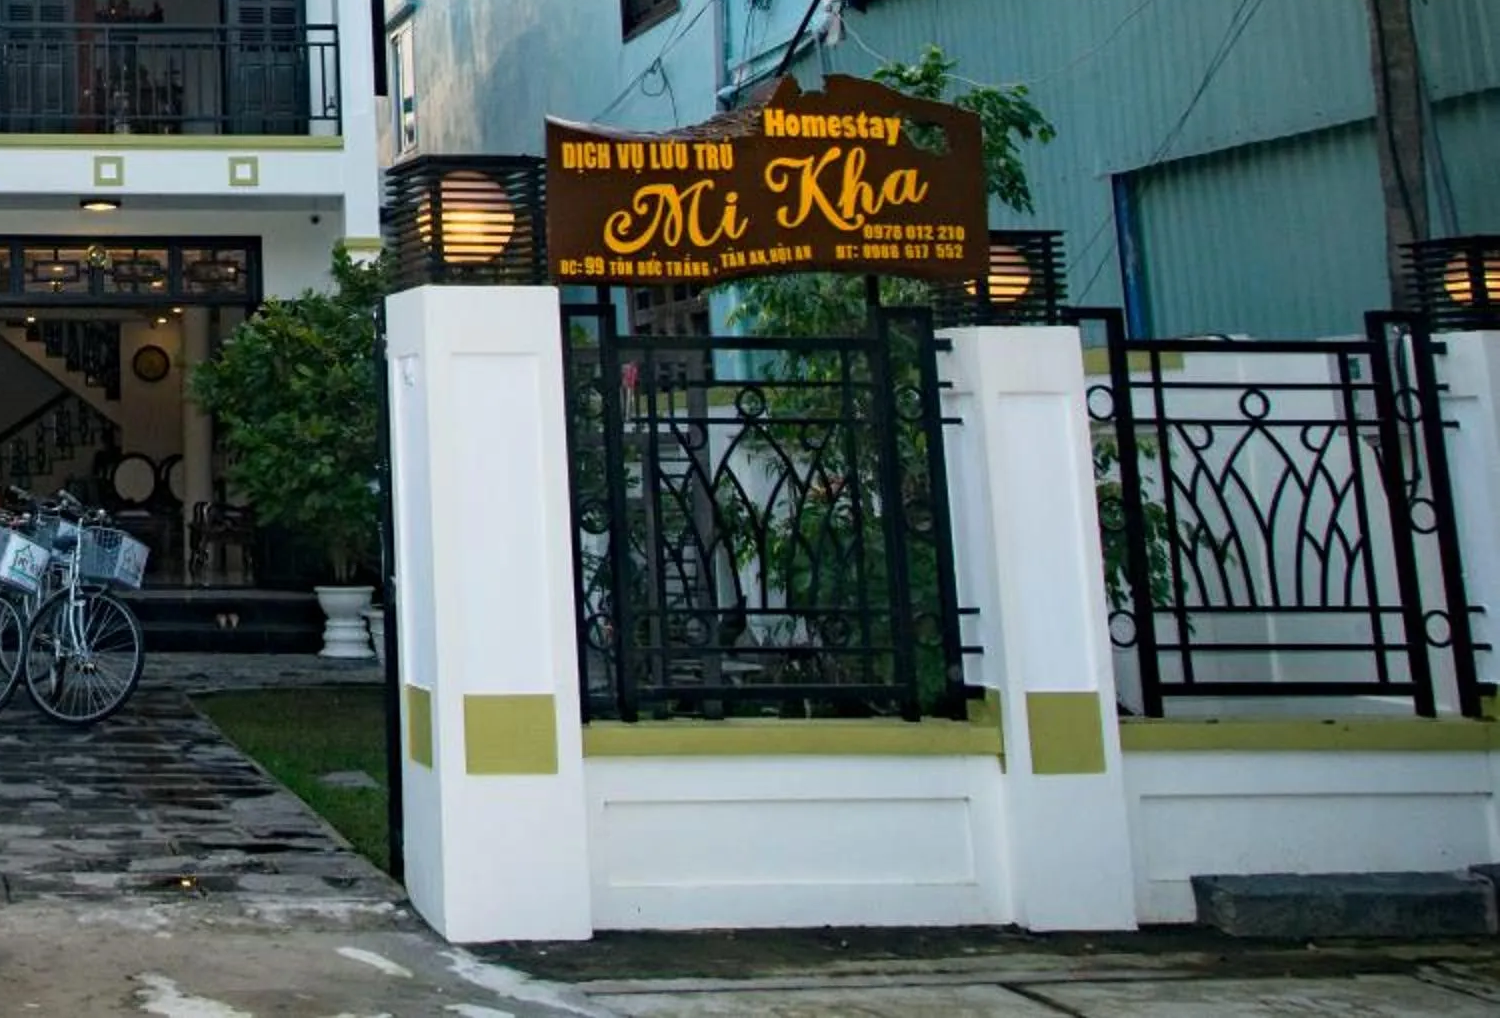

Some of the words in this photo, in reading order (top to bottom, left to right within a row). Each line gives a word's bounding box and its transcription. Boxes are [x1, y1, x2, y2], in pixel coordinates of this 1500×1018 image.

[764, 109, 901, 147] Homestay
[562, 142, 611, 173] DỊCH
[616, 142, 645, 173] VỤ
[650, 139, 689, 170] LƯU
[693, 136, 734, 171] TRÚ
[603, 179, 748, 254] Mi
[765, 146, 928, 230] Kha
